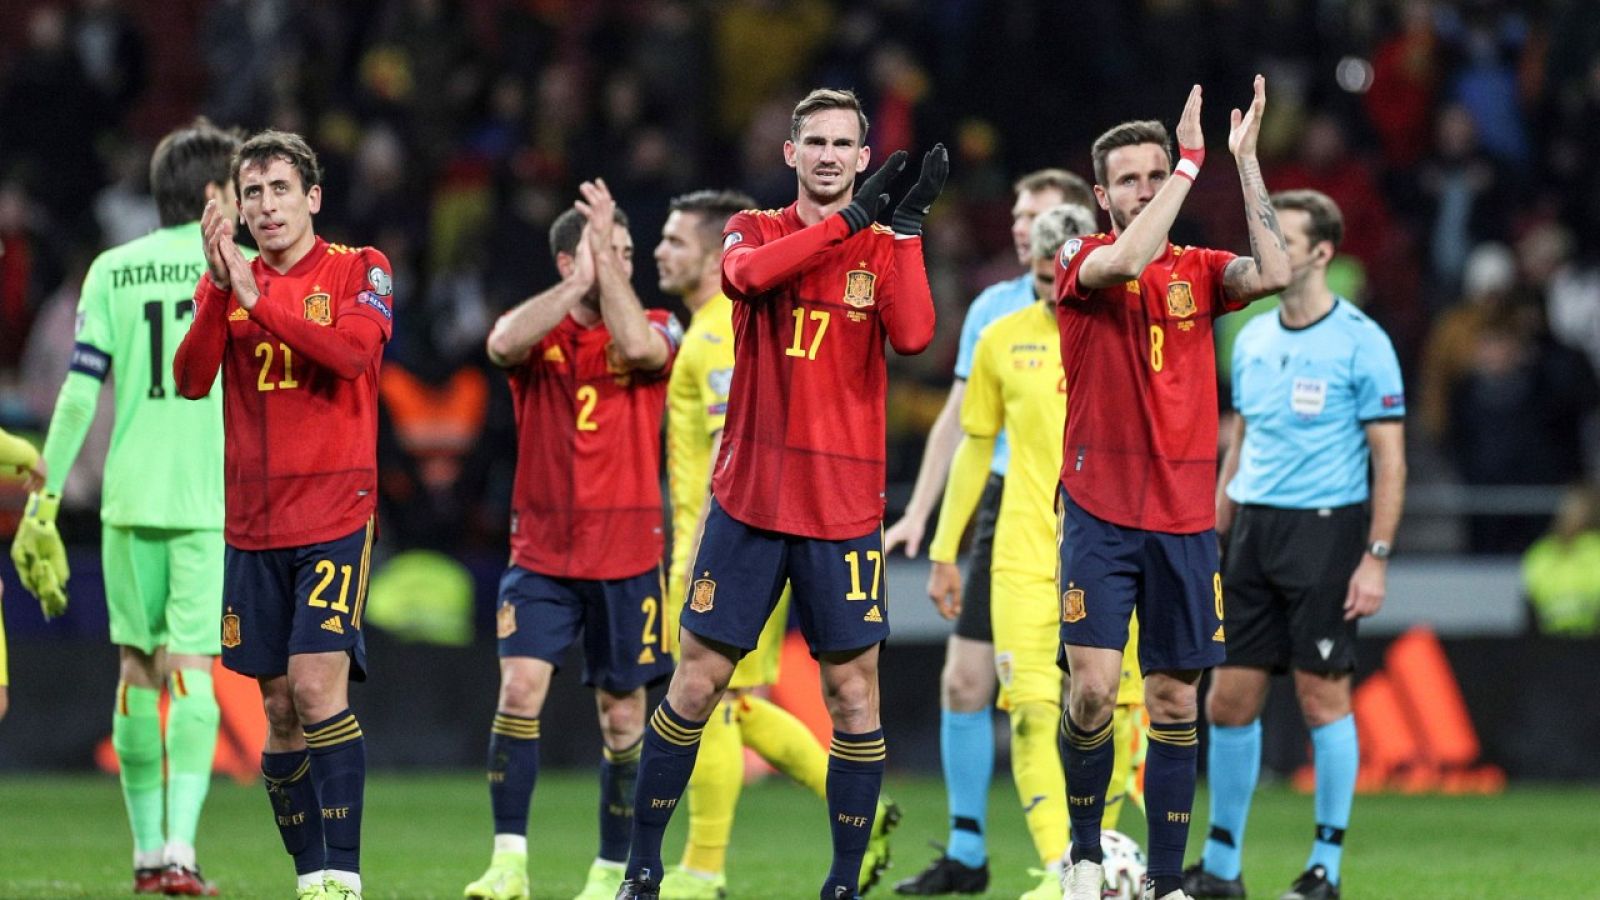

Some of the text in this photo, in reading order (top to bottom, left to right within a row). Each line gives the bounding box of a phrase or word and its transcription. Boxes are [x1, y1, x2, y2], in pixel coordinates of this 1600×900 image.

[785, 307, 830, 360] 17
[1150, 325, 1164, 372] 8
[255, 342, 298, 391] 21
[577, 385, 597, 431] 2
[308, 560, 352, 614] 21
[845, 551, 881, 600] 17
[1213, 572, 1224, 620] 8
[641, 596, 657, 644] 2
[321, 806, 349, 819] RFEF
[838, 813, 867, 828] RFEF
